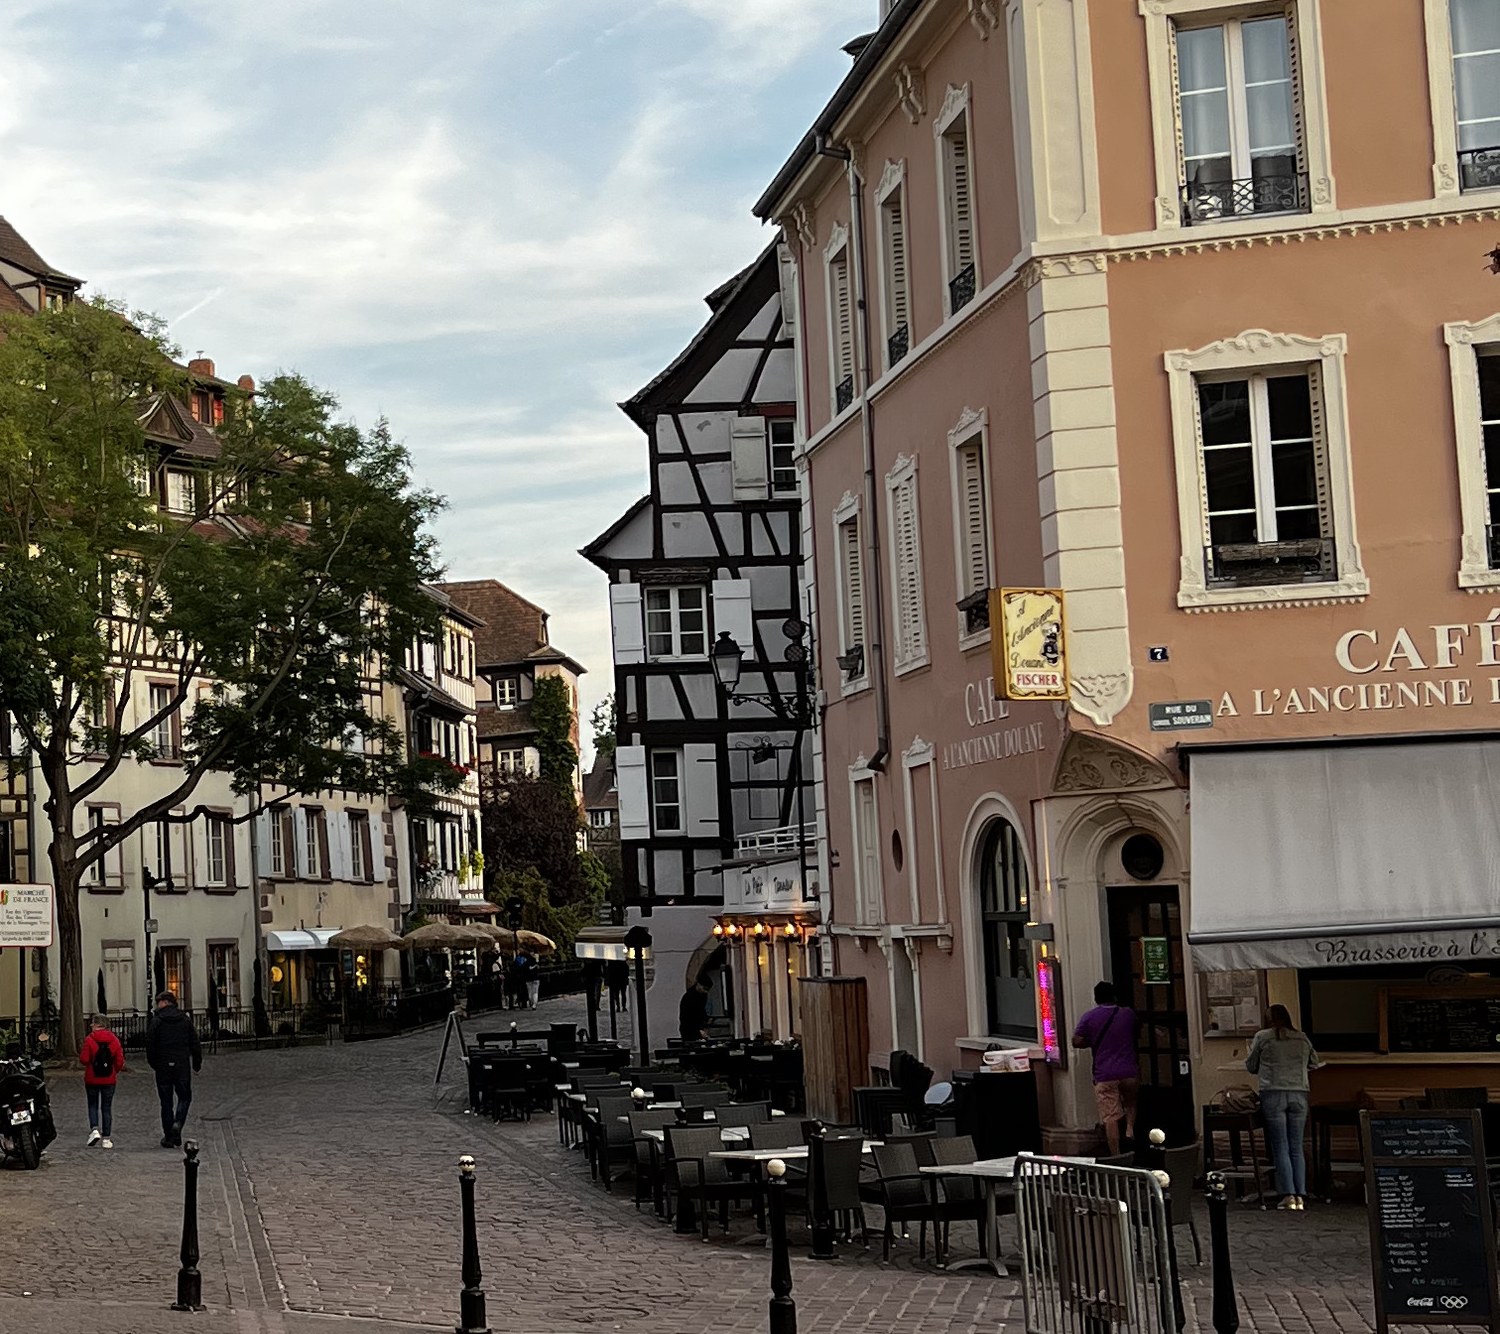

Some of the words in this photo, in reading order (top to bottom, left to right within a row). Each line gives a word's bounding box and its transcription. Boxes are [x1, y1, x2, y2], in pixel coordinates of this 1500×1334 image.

[1153, 648, 1163, 660] 7
[1016, 673, 1058, 686] FISCHER
[1216, 691, 1239, 717] A
[1252, 678, 1473, 716] L'ANCIENNE
[1165, 704, 1182, 714] RUE
[1185, 704, 1197, 713] DU
[1172, 714, 1211, 725] SOUVERAIN
[1004, 721, 1046, 759] DOUANE
[1315, 939, 1443, 963] Brasserie
[1447, 939, 1464, 957] à
[1406, 1297, 1434, 1307] Coca-Cola
